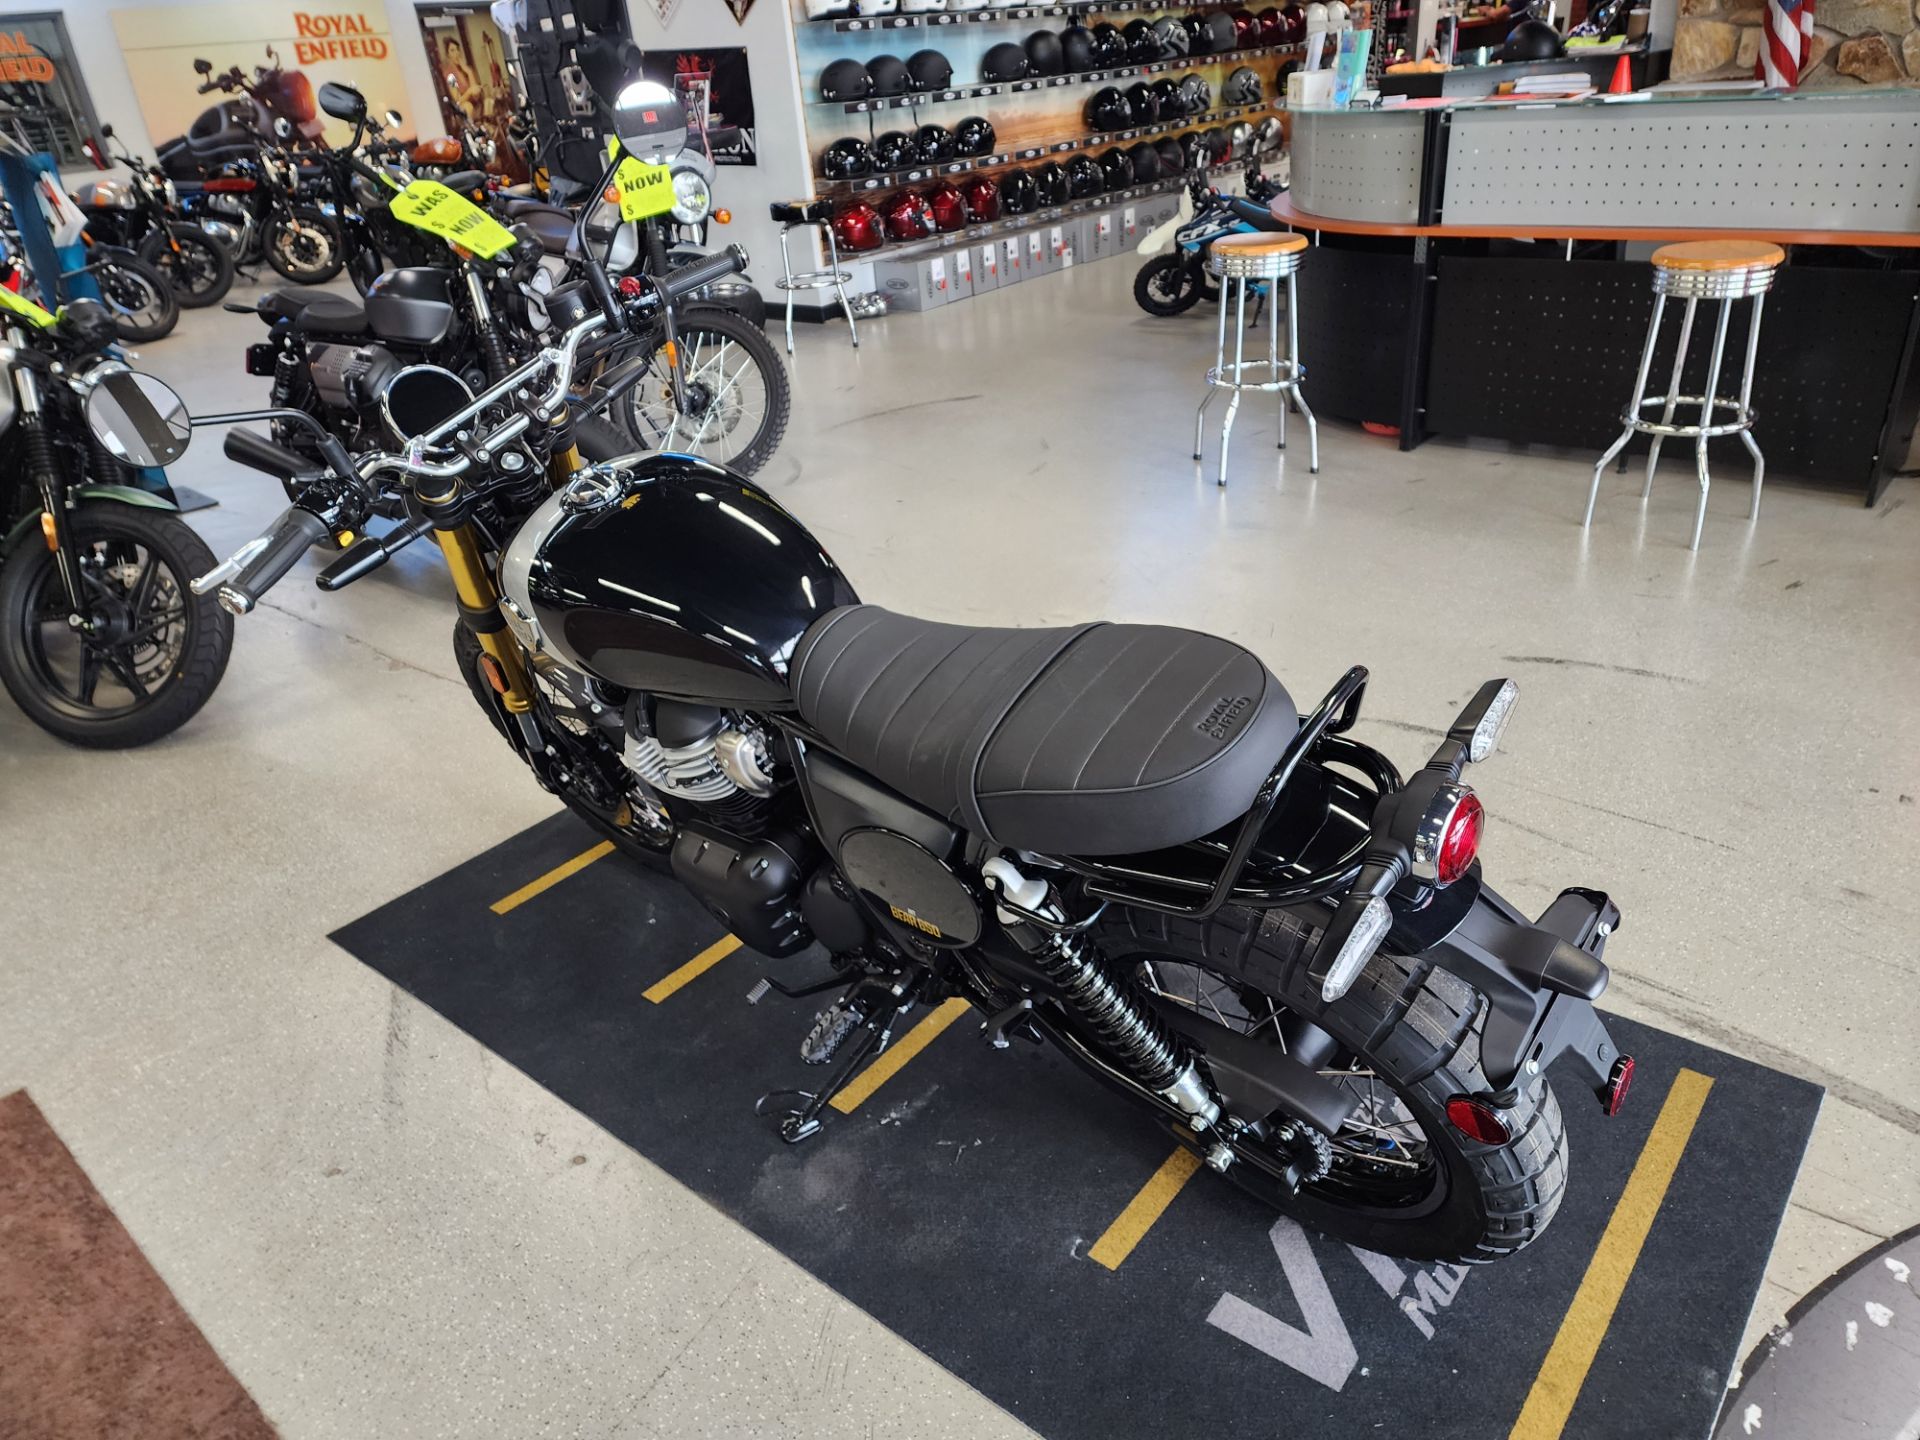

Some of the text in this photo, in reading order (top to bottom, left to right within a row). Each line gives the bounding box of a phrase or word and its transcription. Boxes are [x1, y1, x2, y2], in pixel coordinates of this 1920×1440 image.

[293, 12, 373, 38] ROYAL
[294, 38, 388, 65] ENFIELD
[623, 171, 663, 193] NOW
[410, 189, 449, 217] WAS
[449, 211, 485, 236] NOW
[1197, 697, 1235, 732] ROYAL
